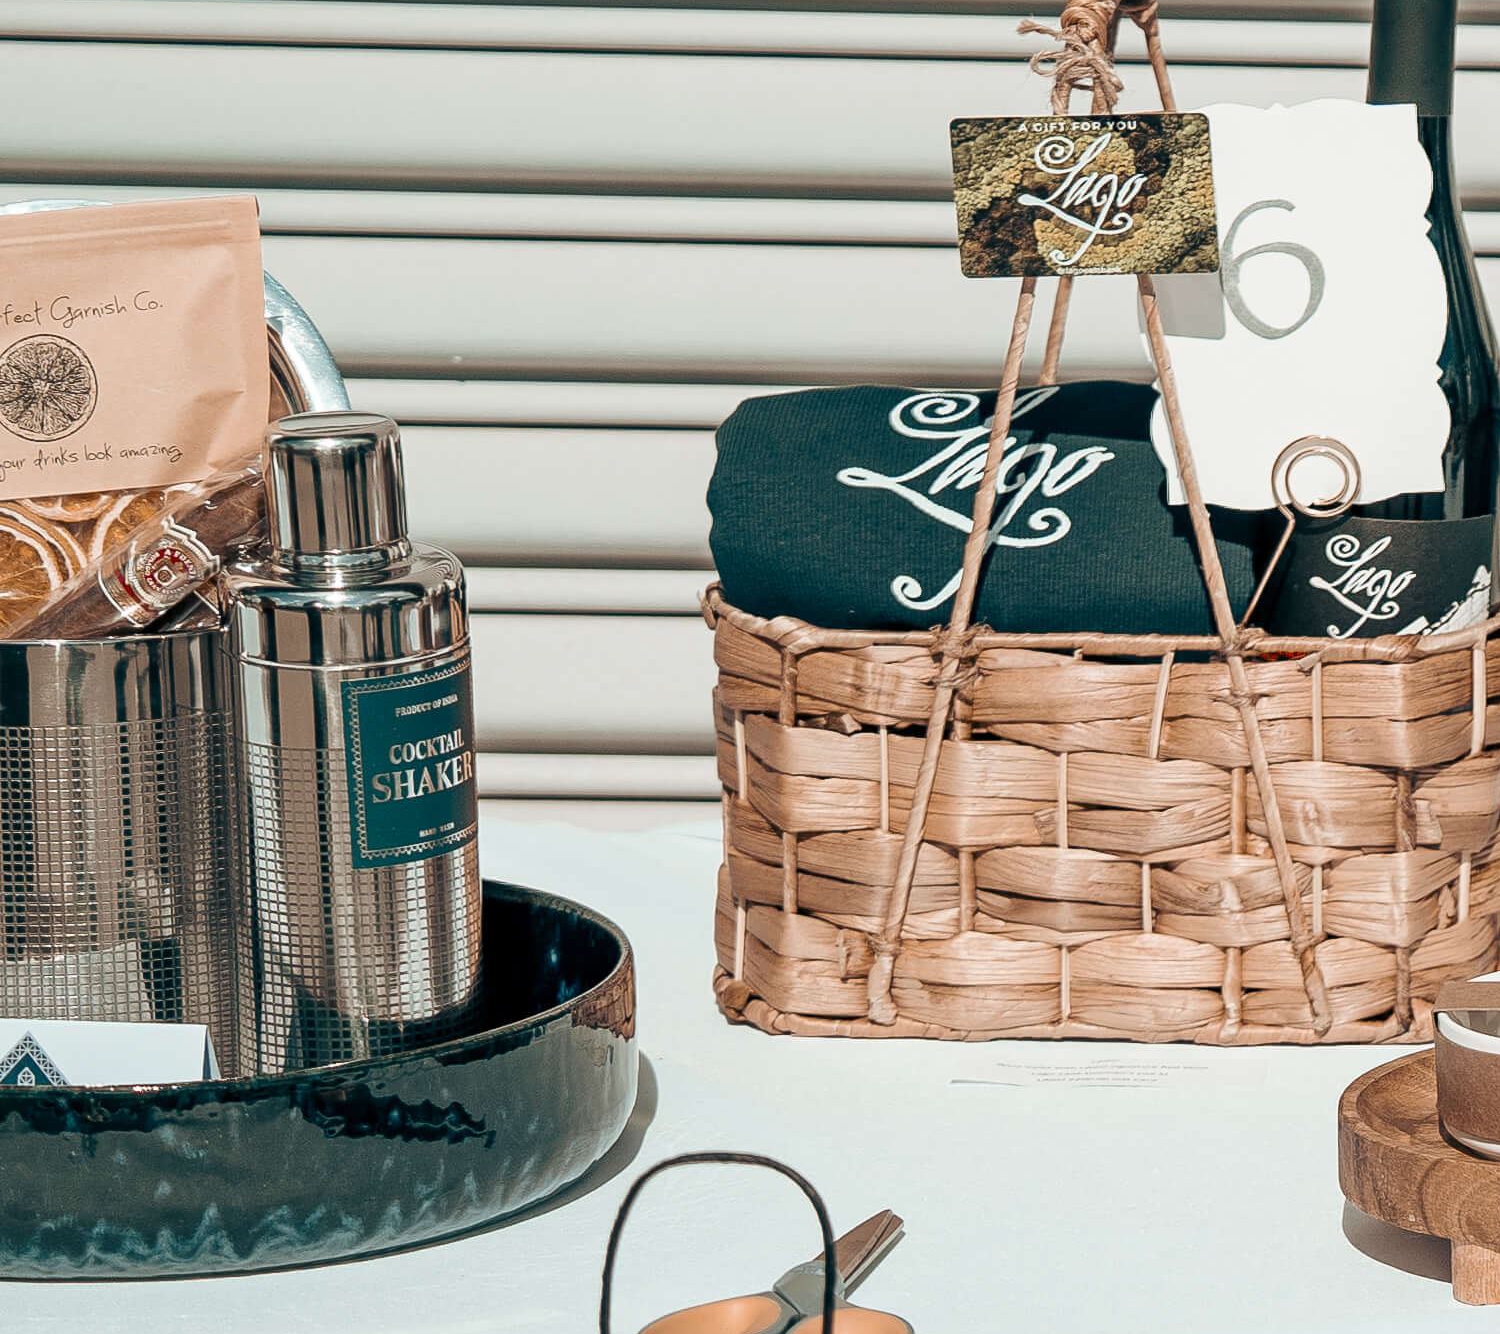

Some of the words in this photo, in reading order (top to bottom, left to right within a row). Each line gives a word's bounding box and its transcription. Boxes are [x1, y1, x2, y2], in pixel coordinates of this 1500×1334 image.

[1018, 123, 1028, 132] A
[1032, 122, 1067, 132] GIFT
[1072, 121, 1101, 131] FOR
[1106, 120, 1137, 131] YOU
[1017, 132, 1148, 265] Lago
[1222, 198, 1327, 340] 6
[50, 295, 127, 328] Garnish
[134, 290, 164, 312] Co.
[33, 446, 79, 471] drinks
[84, 443, 113, 463] look
[120, 445, 183, 464] amazing
[1308, 533, 1417, 639] Lago
[395, 702, 431, 718] PRODUCT
[432, 698, 442, 709] OF
[389, 728, 465, 765] COCKTAIL
[371, 750, 473, 804] SHAKER
